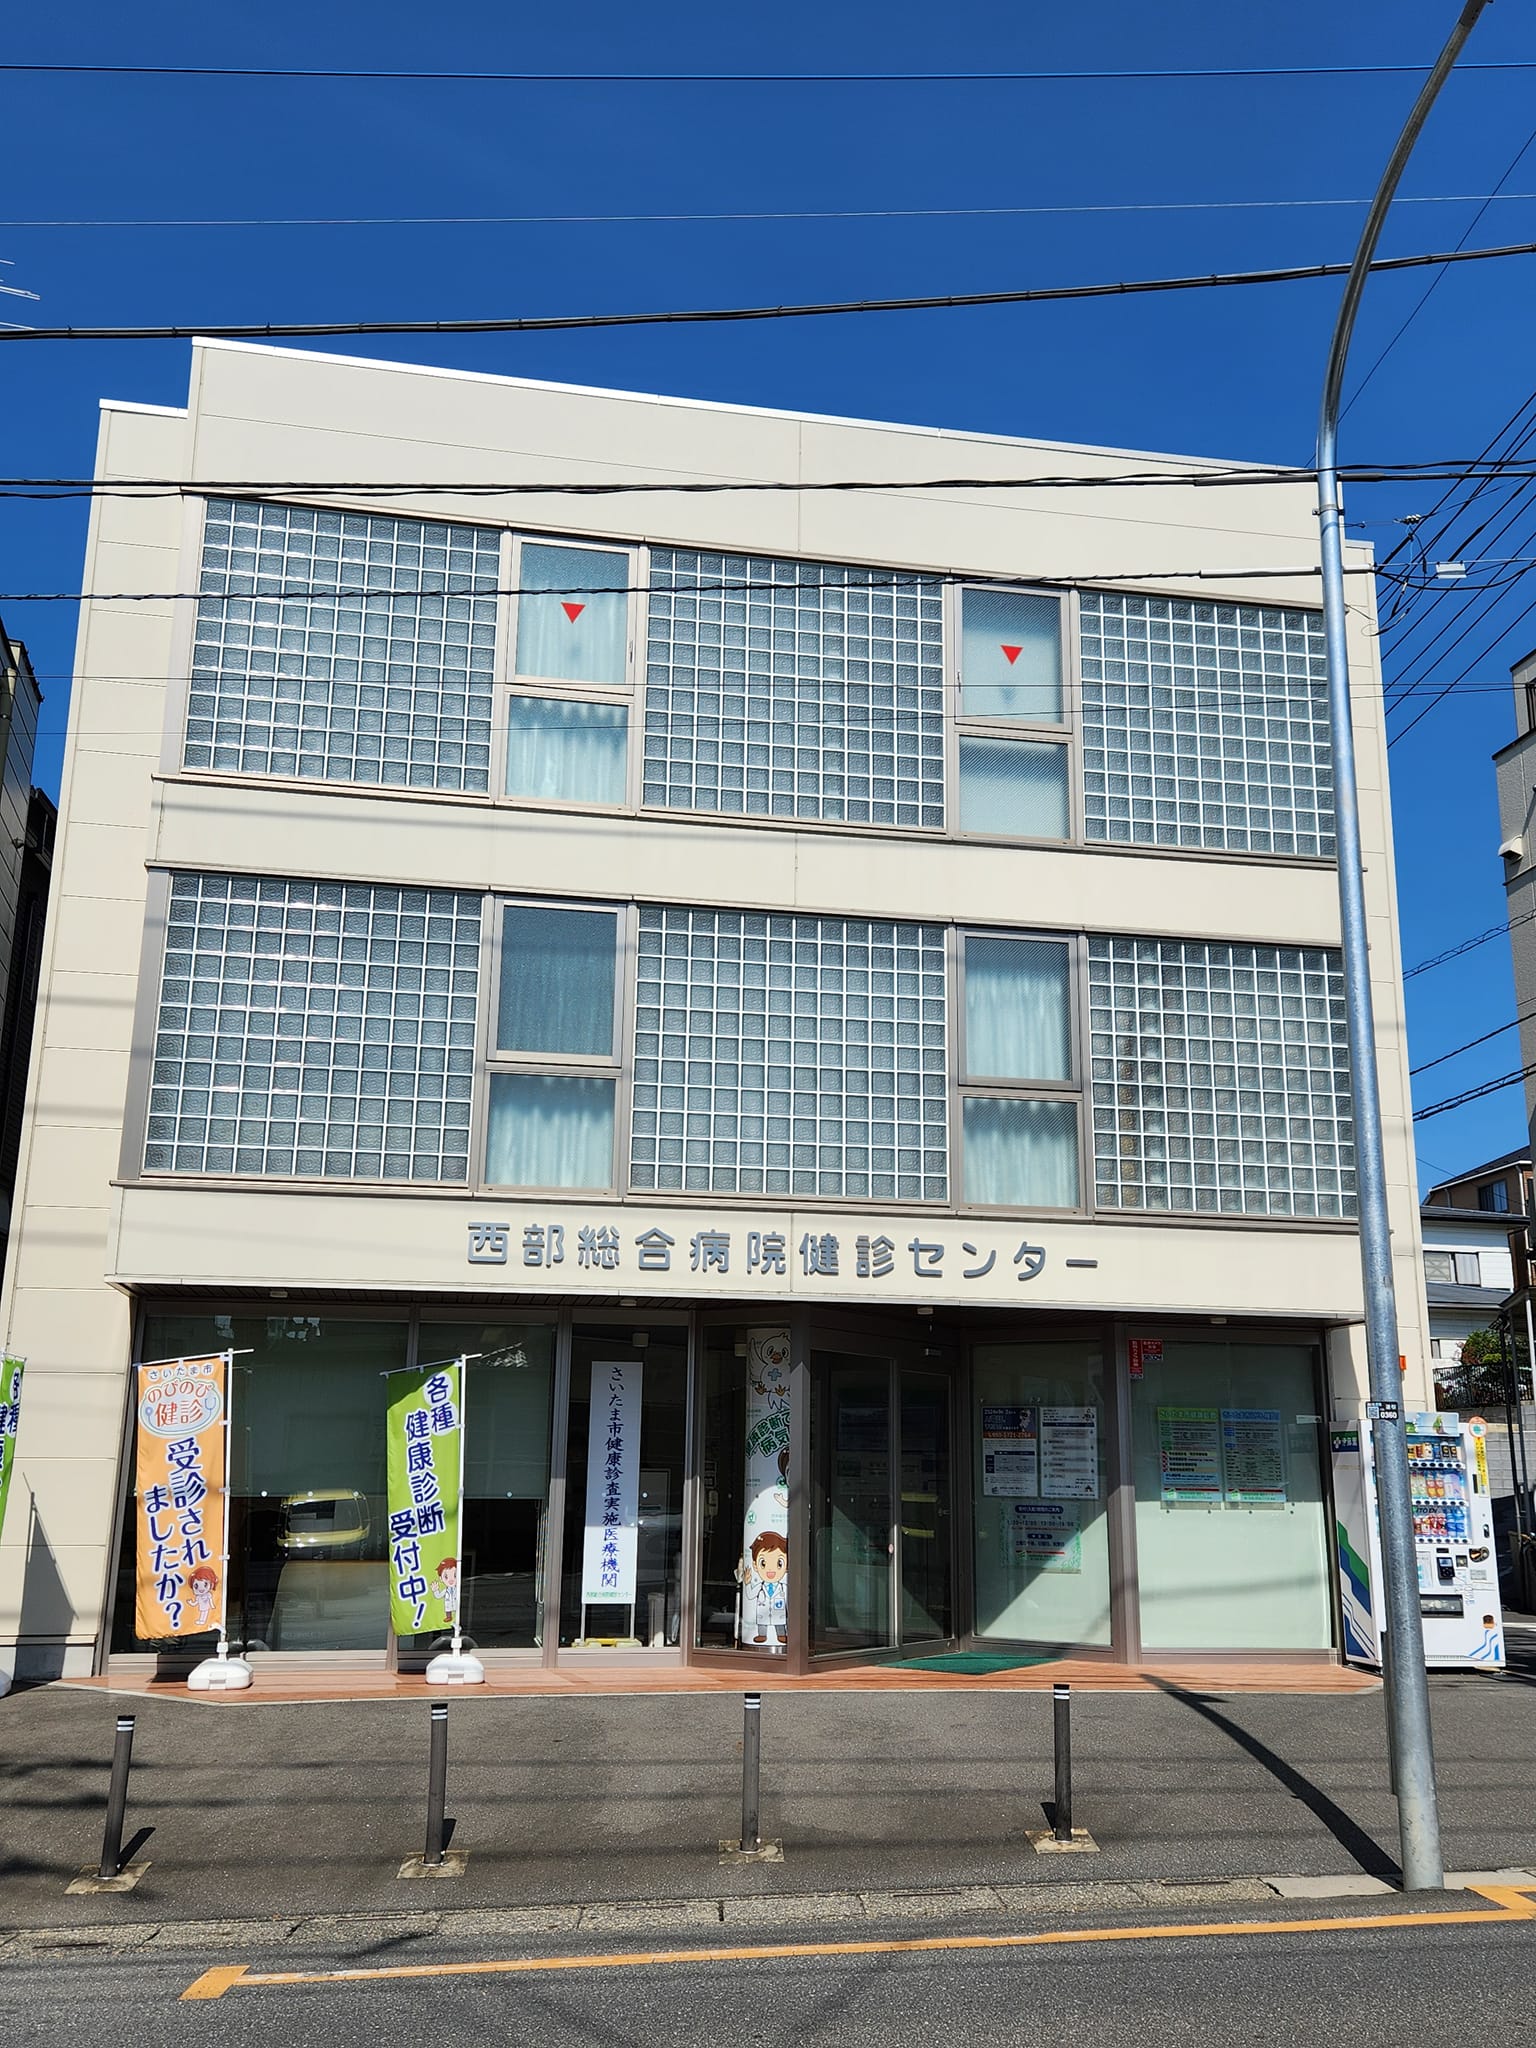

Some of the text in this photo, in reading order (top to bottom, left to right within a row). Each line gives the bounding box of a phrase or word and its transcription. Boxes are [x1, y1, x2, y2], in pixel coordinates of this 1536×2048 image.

[466, 1221, 1099, 1281] 西部総合病院健診センター
[148, 1380, 212, 1404] のびのび
[149, 1364, 213, 1380] さいたま市
[155, 1399, 204, 1428] 健診
[426, 1374, 457, 1432] 各種
[405, 1408, 446, 1537] 健康診断
[600, 1366, 625, 1589] さいたま市健康診査実施医療機関
[167, 1437, 211, 1568] 受診され
